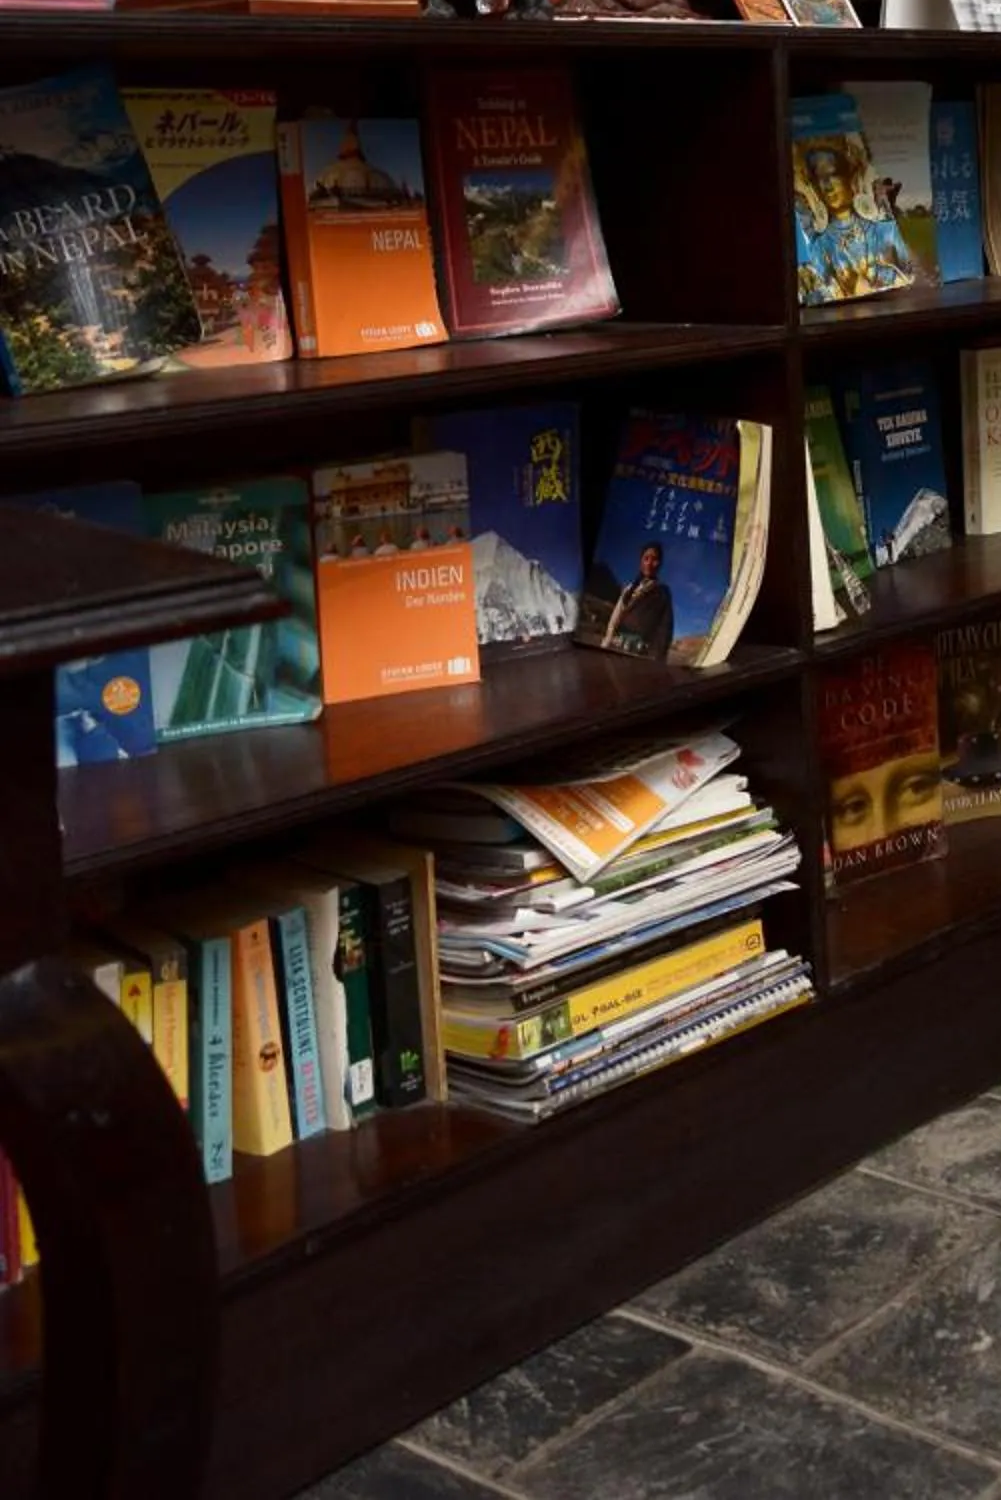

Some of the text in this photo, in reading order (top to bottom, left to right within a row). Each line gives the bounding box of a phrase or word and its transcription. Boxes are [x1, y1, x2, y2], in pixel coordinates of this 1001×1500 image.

[454, 115, 559, 150] NEPAL
[13, 184, 137, 239] BEARD
[28, 216, 149, 269] NEPAL
[371, 230, 422, 251] NEPAL
[396, 564, 464, 592] INDIEN
[841, 692, 913, 732] CODE
[833, 825, 941, 874] DAN BROWN
[289, 946, 315, 1056] LISA SCOTTOLINE
